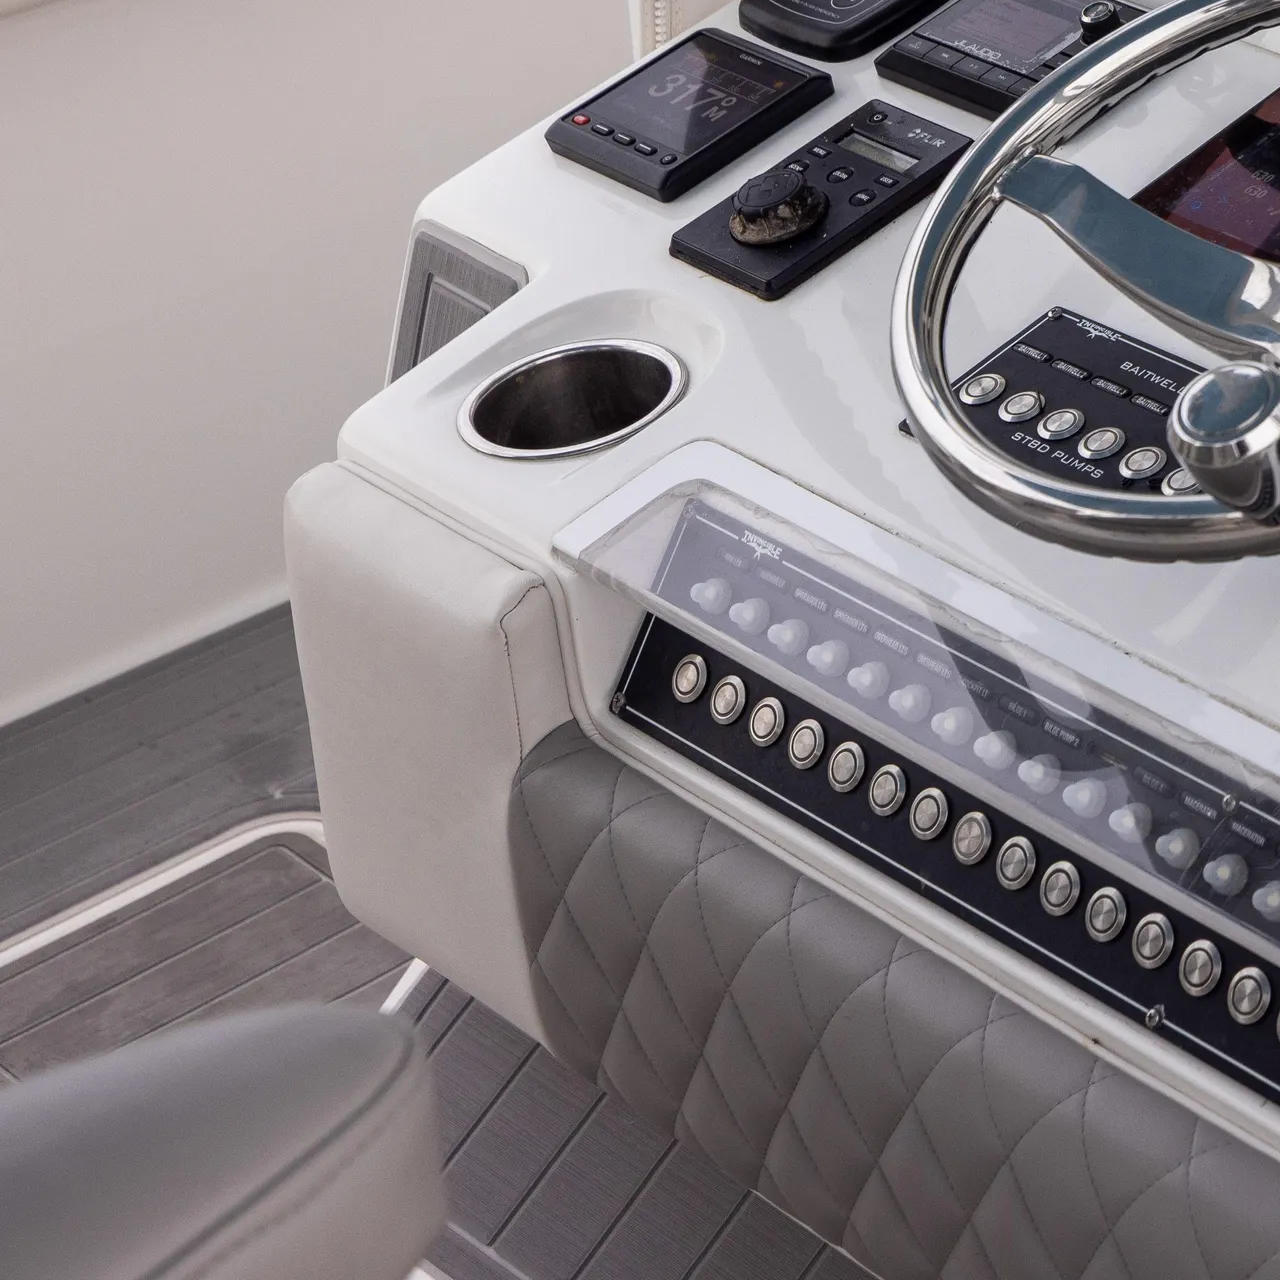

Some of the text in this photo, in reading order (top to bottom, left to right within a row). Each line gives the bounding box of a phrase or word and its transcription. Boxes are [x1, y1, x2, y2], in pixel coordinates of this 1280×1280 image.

[648, 73, 728, 112] 317
[917, 131, 947, 148] FLIR
[1017, 343, 1043, 360] BAITWELL
[1056, 361, 1082, 377] BAITWELL
[1096, 379, 1120, 395] BAITWELL
[1136, 396, 1162, 413] BAITWELL
[1010, 432, 1105, 480] STBD PUMPS
[741, 529, 783, 561] INVINCIBLE
